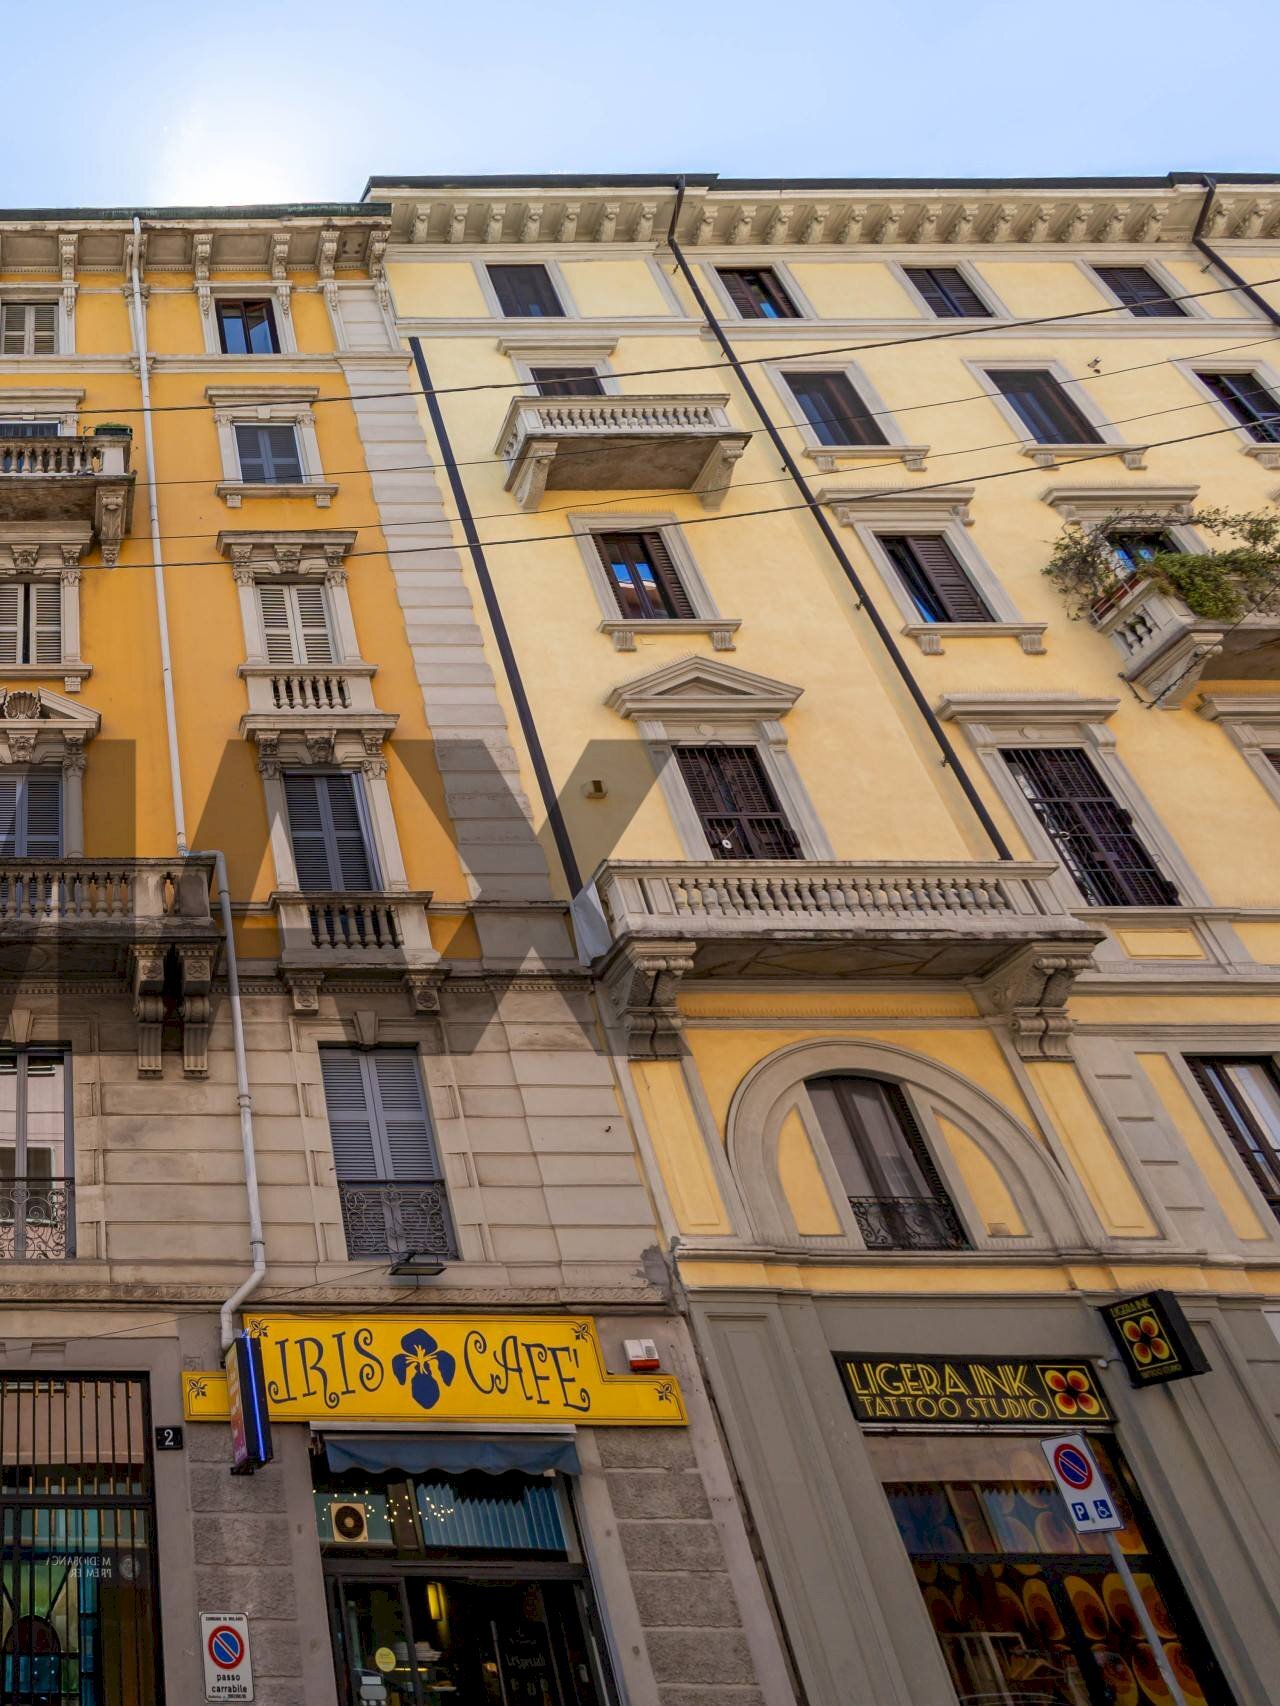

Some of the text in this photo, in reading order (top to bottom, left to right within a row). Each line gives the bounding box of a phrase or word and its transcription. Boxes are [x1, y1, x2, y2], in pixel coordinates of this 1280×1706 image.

[267, 1328, 384, 1409] IRIS
[846, 1363, 1038, 1397] LIGERA INK
[858, 1396, 1052, 1419] TATTOO STUDIO
[164, 1429, 174, 1446] 2
[1074, 1504, 1085, 1520] P
[216, 1674, 240, 1682] passo
[211, 1684, 247, 1693] carrabile
